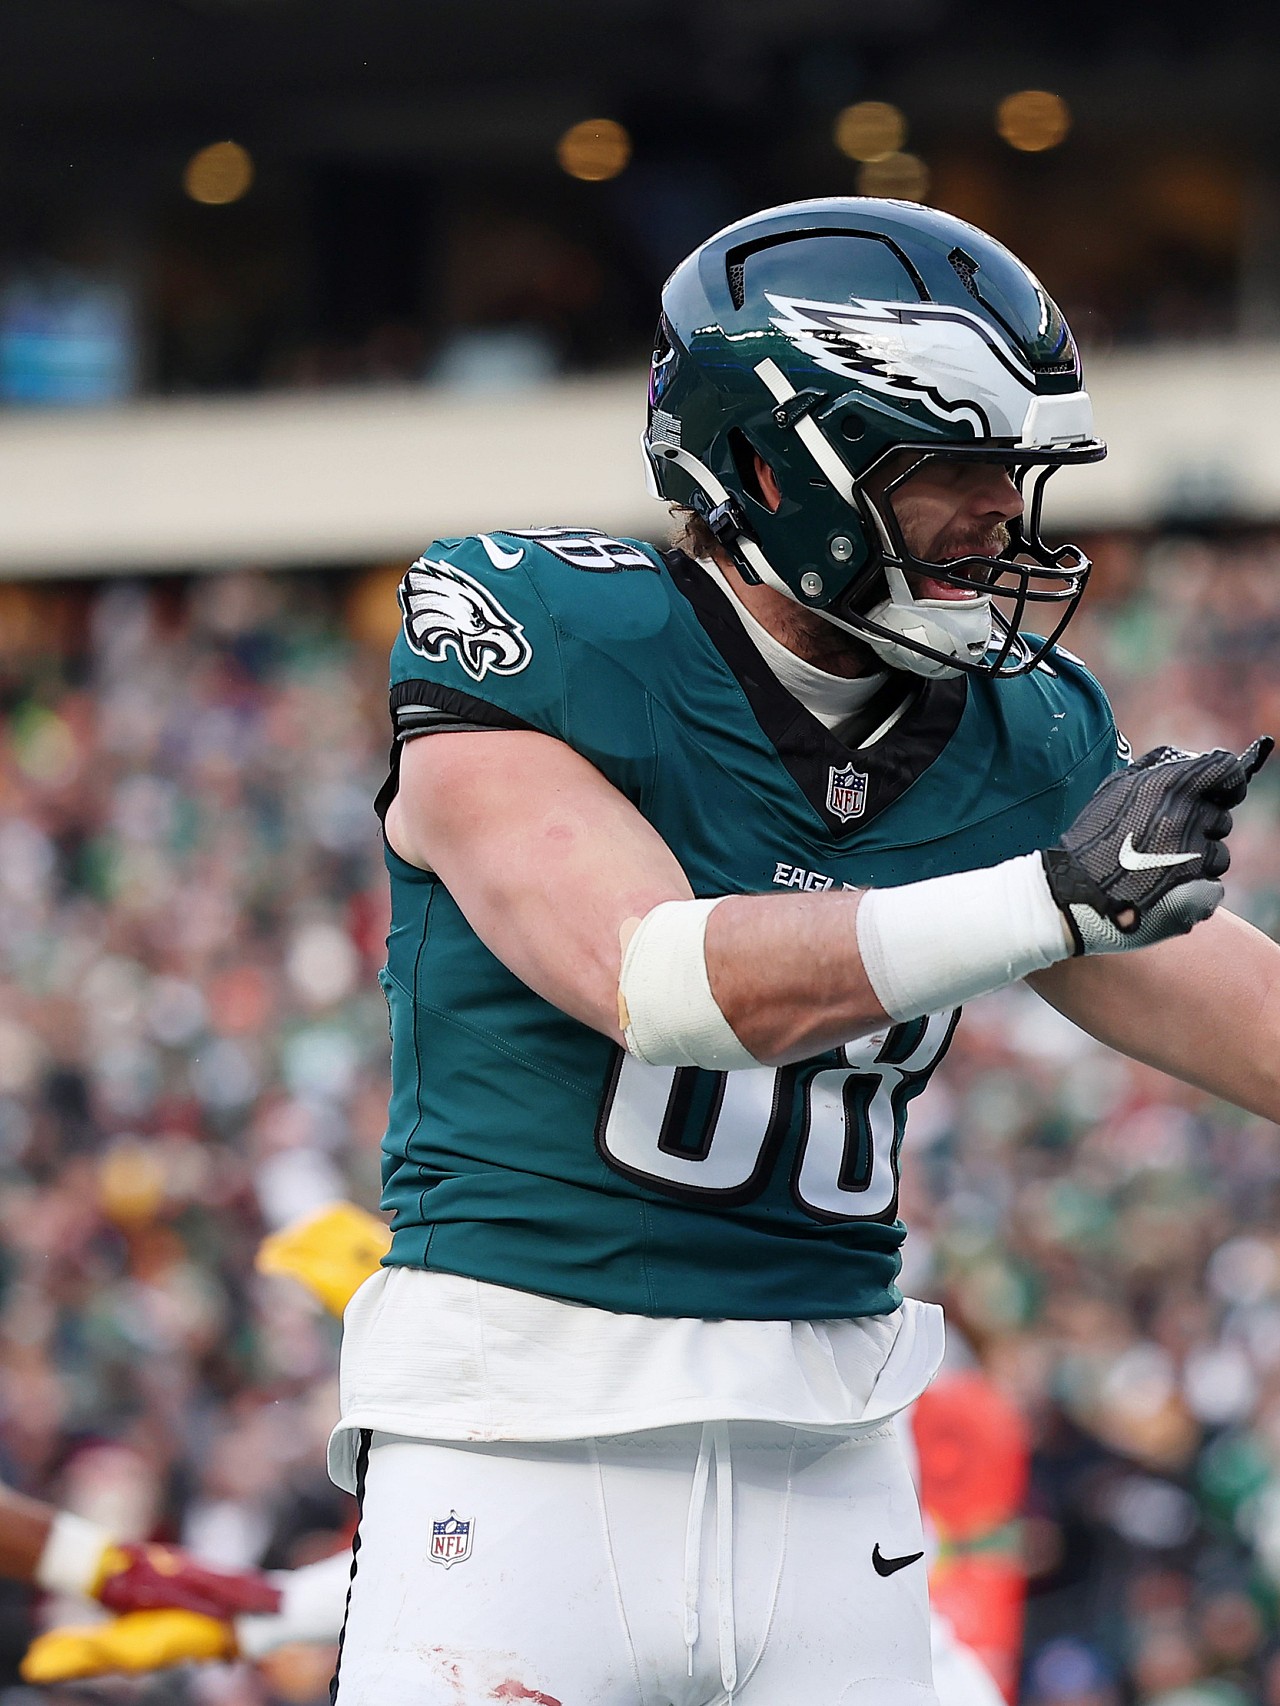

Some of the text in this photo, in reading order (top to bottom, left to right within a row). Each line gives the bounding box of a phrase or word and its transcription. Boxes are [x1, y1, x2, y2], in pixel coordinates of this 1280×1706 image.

[833, 787, 861, 813] NFL
[772, 862, 860, 892] EAGL
[434, 1536, 464, 1557] NFL
